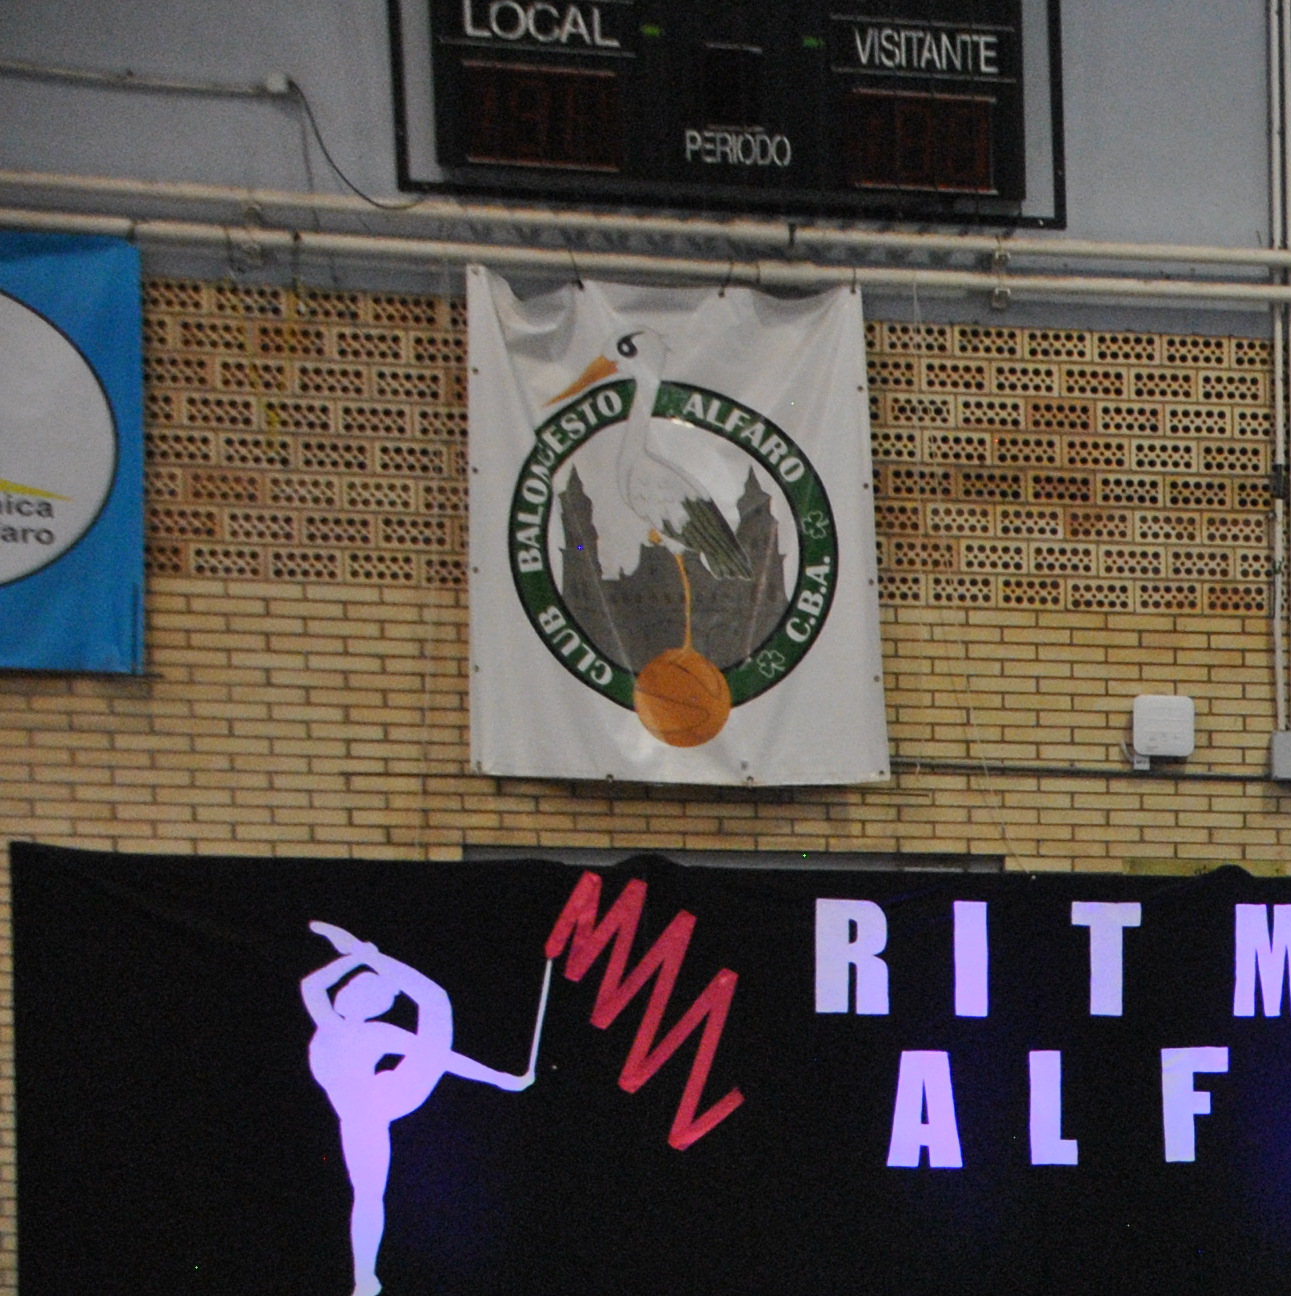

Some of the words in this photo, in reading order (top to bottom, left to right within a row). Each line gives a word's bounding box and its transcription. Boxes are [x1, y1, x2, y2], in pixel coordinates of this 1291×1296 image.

[459, 0, 620, 48] LOCAL
[852, 26, 999, 73] VISITANTE
[685, 129, 792, 166] PERIODO
[539, 605, 614, 685] CLUB
[683, 394, 805, 482] ALFARO
[785, 555, 831, 643] C.B.A.
